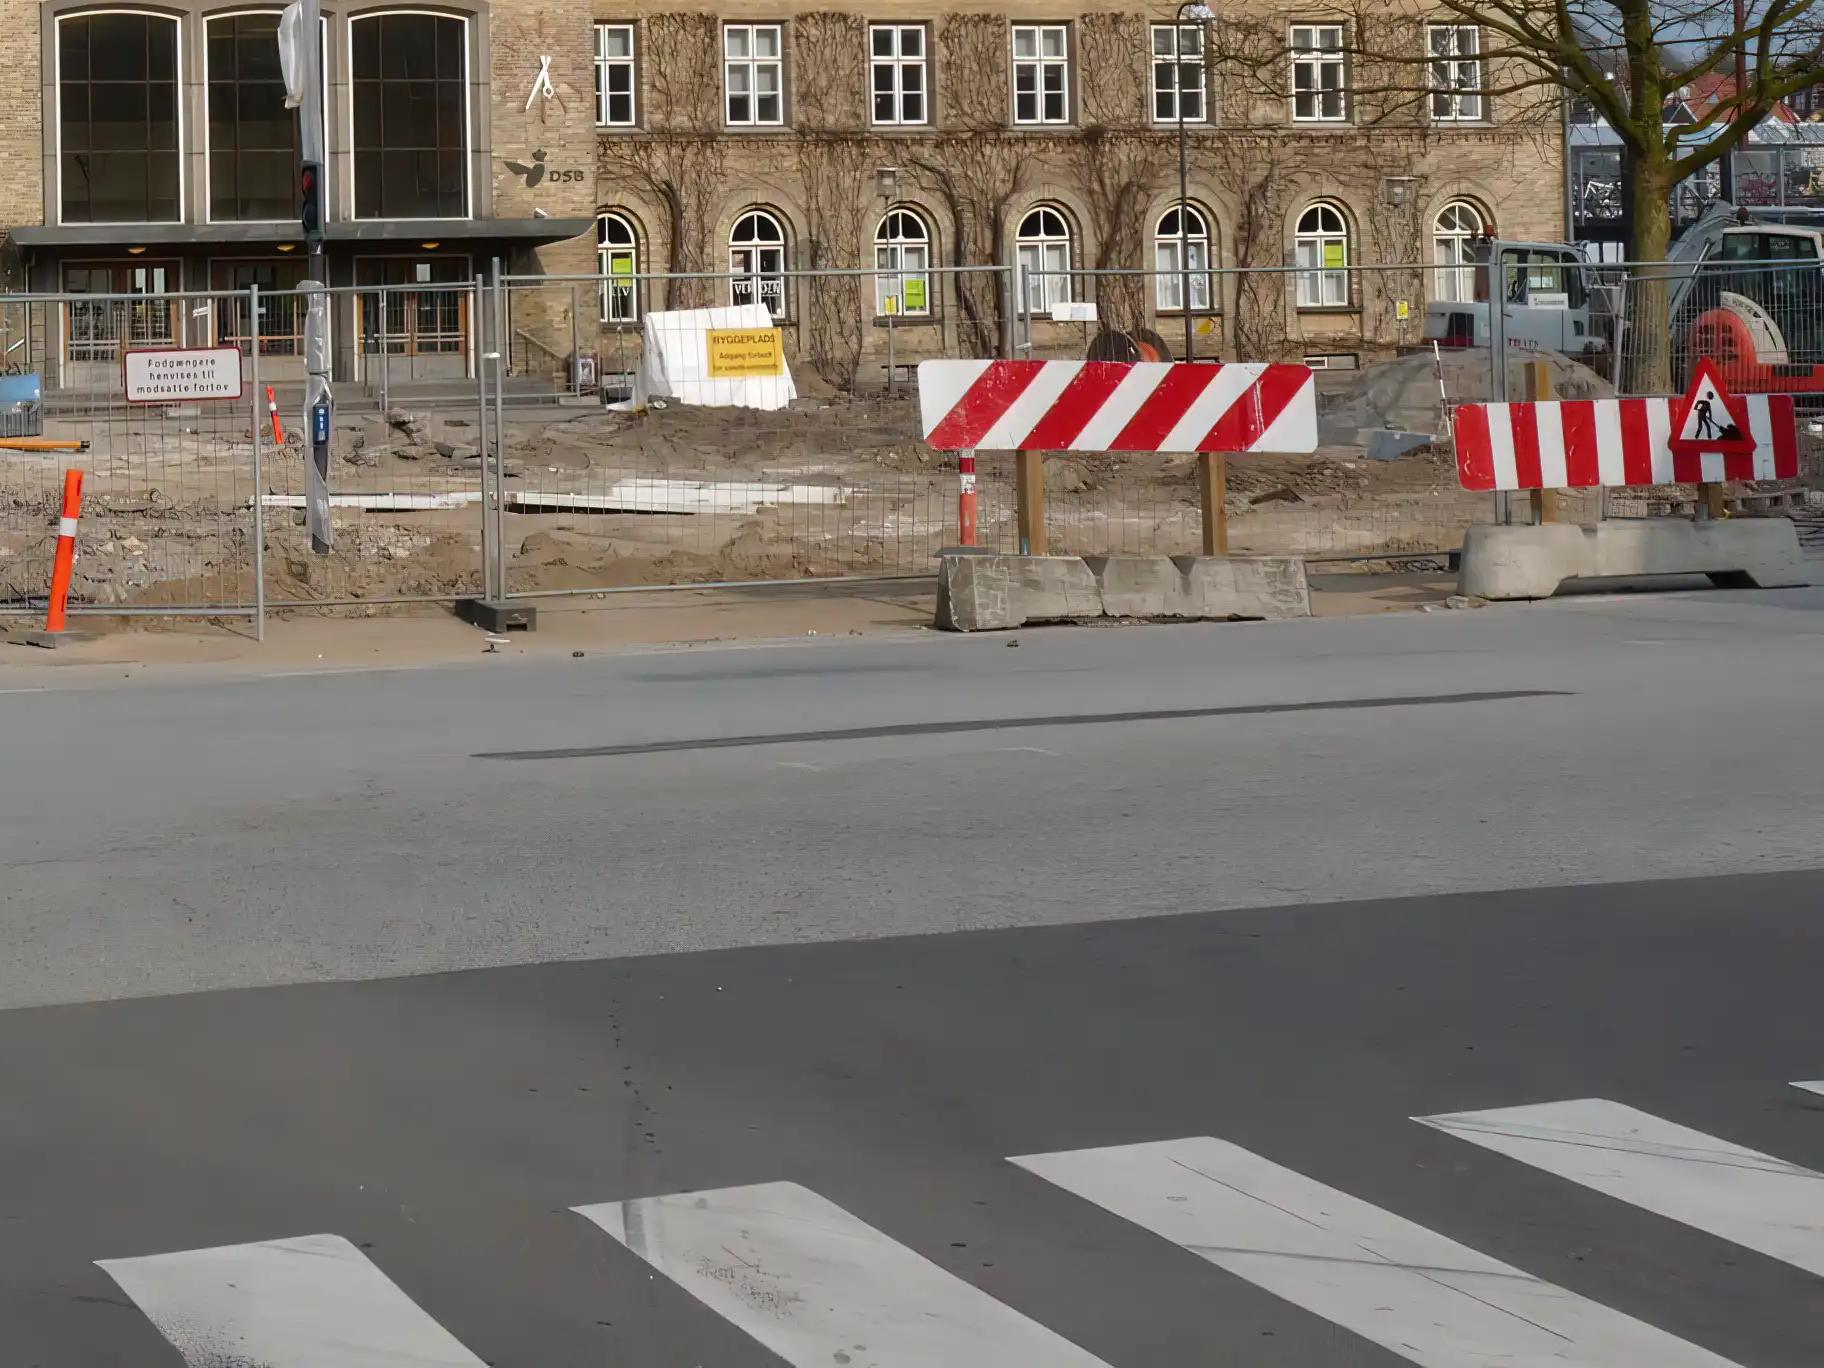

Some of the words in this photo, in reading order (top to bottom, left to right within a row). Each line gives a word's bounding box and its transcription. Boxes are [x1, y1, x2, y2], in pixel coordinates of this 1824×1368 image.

[549, 170, 584, 182] DSB
[148, 359, 216, 369] Fodgængere
[149, 372, 198, 381] henvises
[202, 371, 214, 379] til
[137, 384, 189, 394] modsatte
